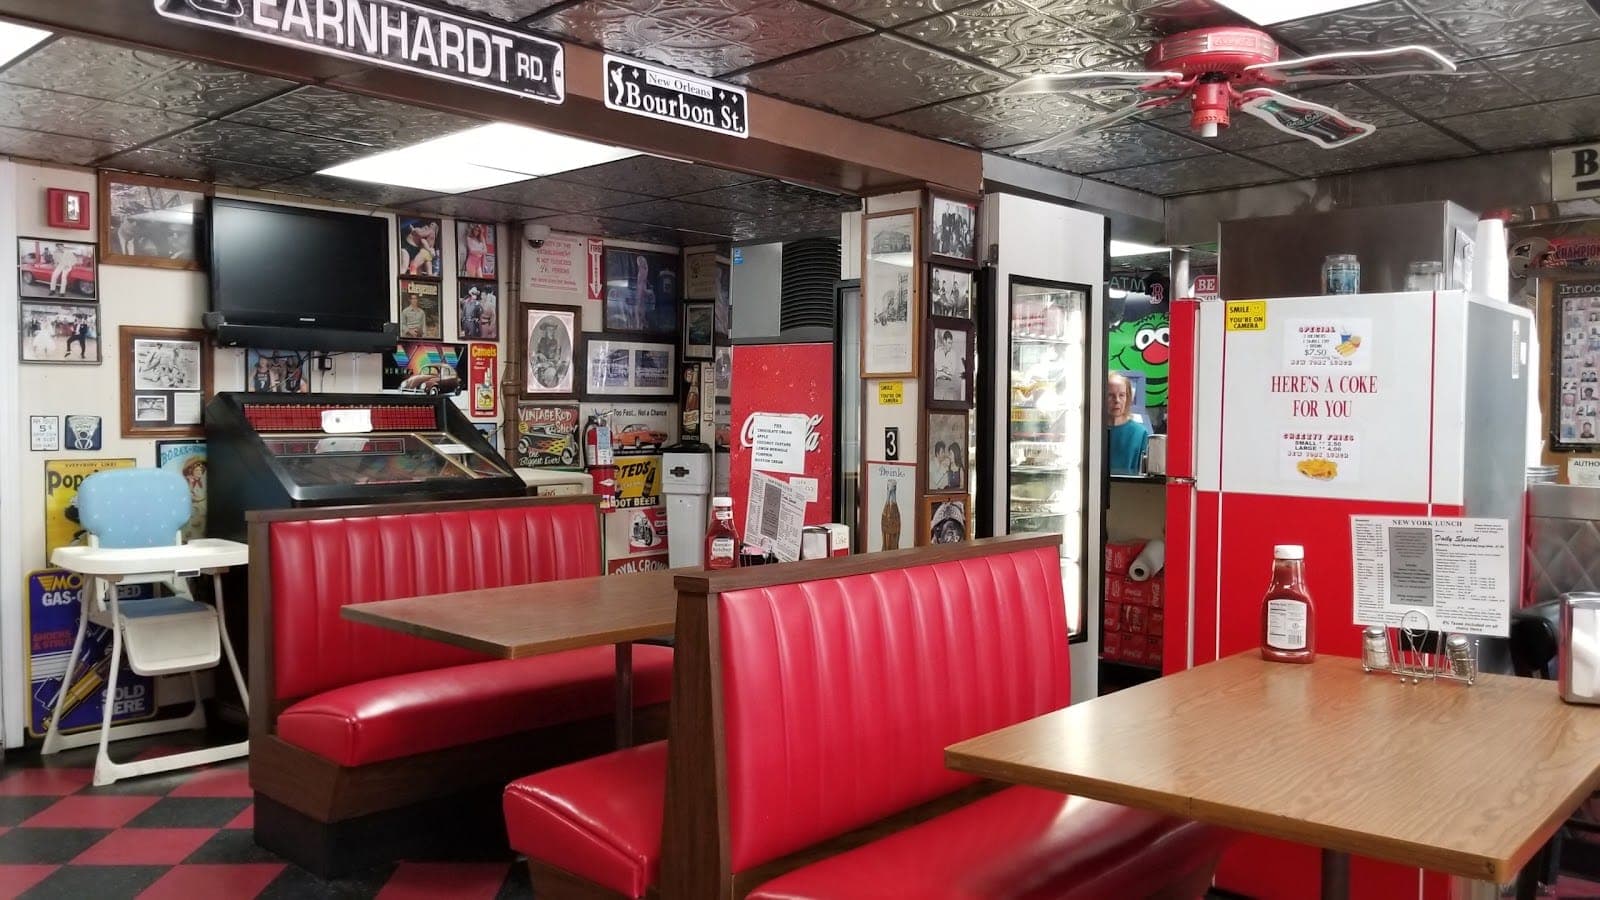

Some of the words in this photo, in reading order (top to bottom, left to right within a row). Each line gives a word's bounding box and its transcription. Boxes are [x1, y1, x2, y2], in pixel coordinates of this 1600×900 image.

[252, 0, 513, 82] EARNHARDT
[517, 52, 547, 83] RD.
[648, 73, 671, 87] New
[674, 79, 711, 98] Orleans
[625, 81, 714, 126] Bourbon
[721, 104, 744, 132] St.
[1109, 276, 1146, 290] ATM
[1271, 375, 1320, 393] HERE'S
[1324, 376, 1334, 393] A
[1339, 375, 1378, 394] COKE
[518, 407, 555, 422] VINTAGE
[613, 408, 622, 417] Too
[637, 409, 646, 417] Not
[650, 409, 668, 417] Chance
[1293, 399, 1319, 417] FOR
[1324, 400, 1352, 418] YOU
[886, 431, 896, 456] 3
[621, 460, 651, 478] TED'S
[633, 496, 656, 507] BEER
[1435, 520, 1463, 528] LUNCH
[1434, 534, 1453, 543] Daily
[1455, 535, 1480, 543] Special
